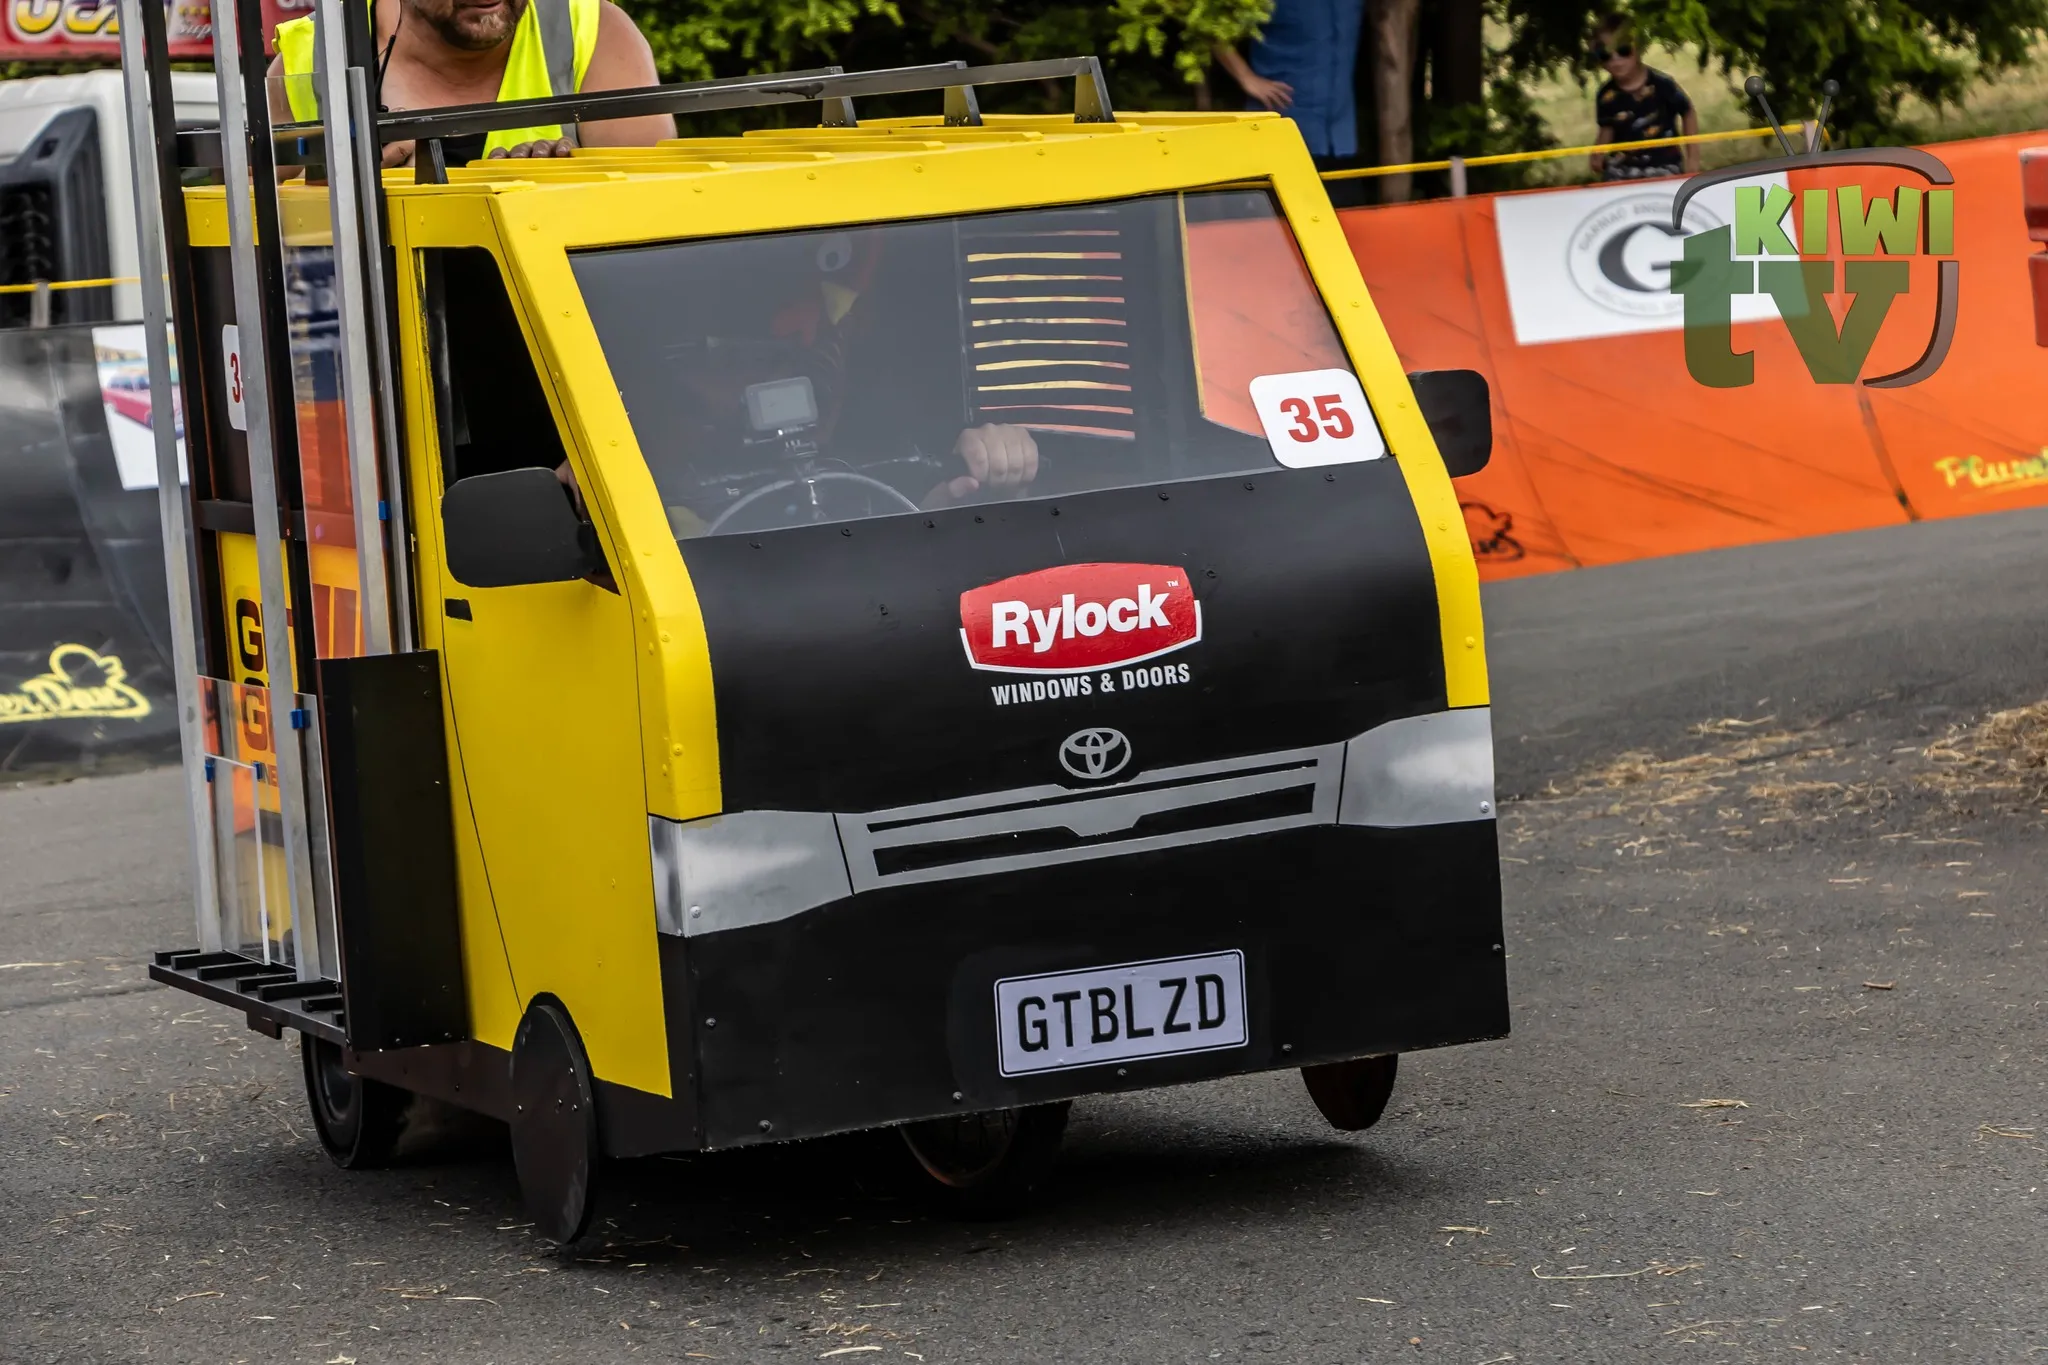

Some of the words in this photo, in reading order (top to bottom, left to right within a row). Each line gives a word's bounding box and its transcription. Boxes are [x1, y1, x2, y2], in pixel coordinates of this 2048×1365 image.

[1279, 393, 1355, 444] 35
[991, 583, 1171, 653] Rylock
[991, 675, 1093, 706] WINDOWS
[1100, 672, 1116, 693] &
[1121, 662, 1191, 691] DOORS
[1017, 973, 1226, 1053] GTBLZD
